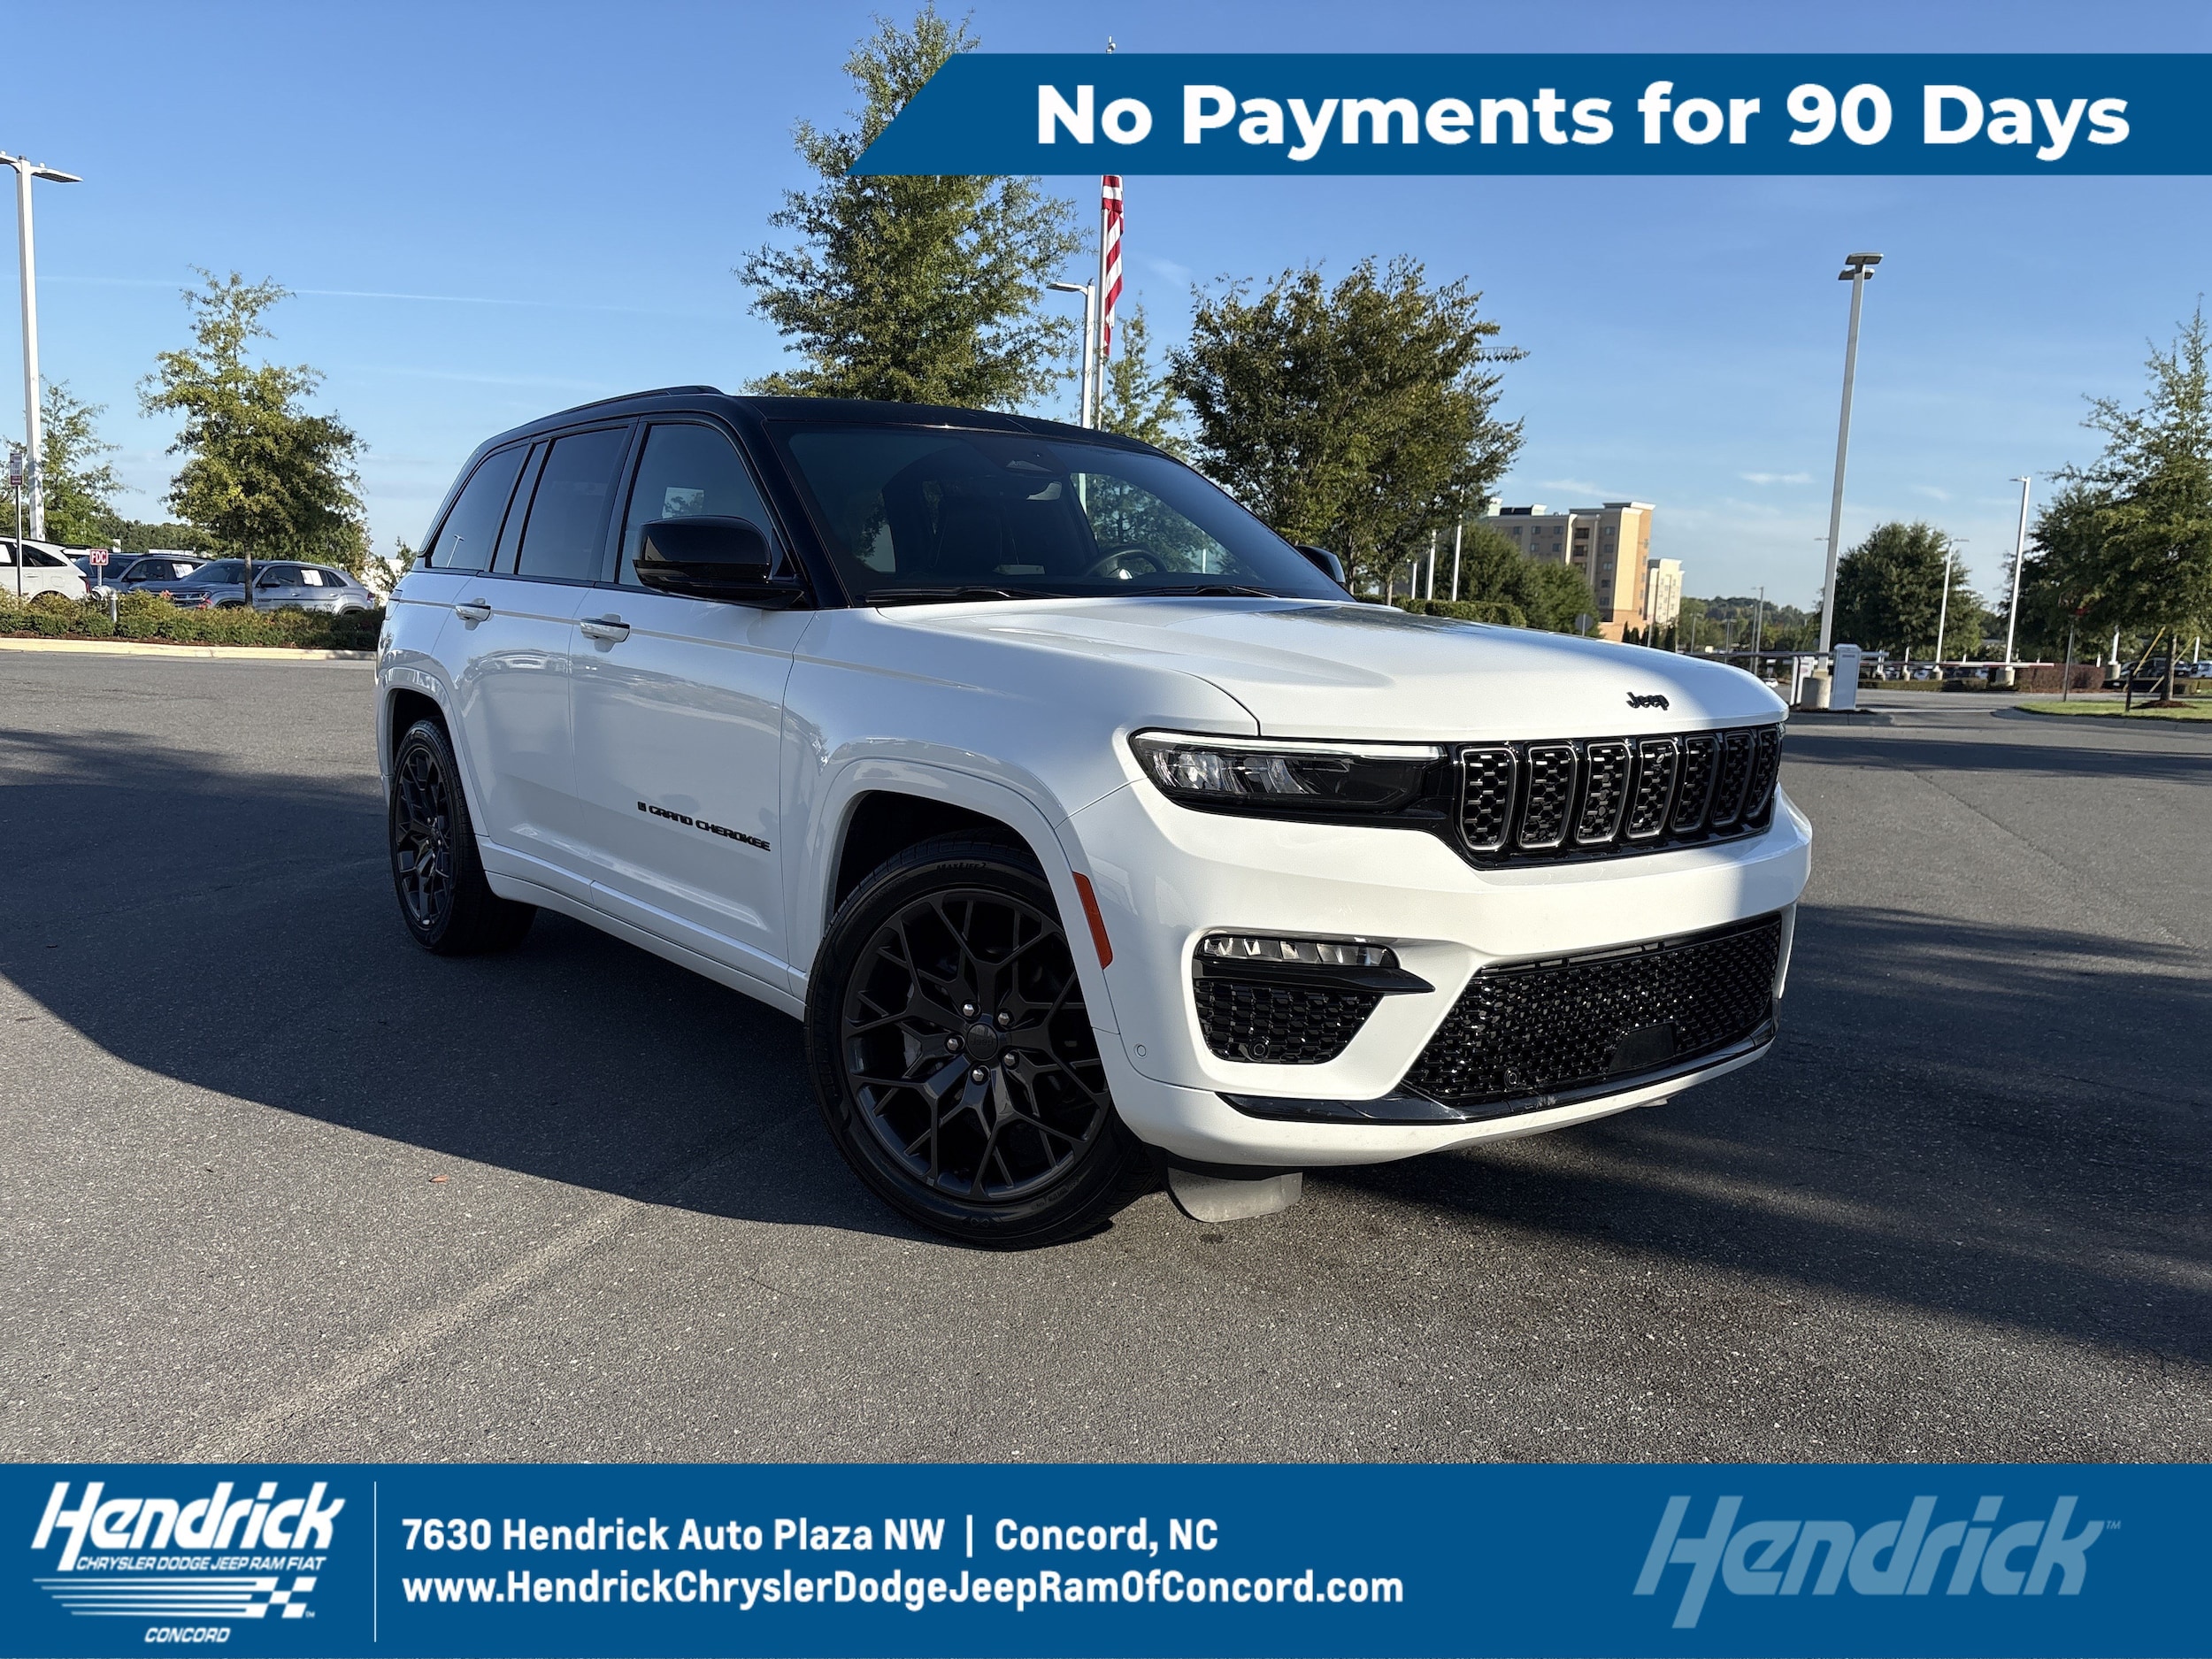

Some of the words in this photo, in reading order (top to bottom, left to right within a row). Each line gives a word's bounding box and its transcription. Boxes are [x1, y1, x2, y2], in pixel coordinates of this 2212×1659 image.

[91, 550, 106, 564] FDC
[1626, 691, 1670, 710] Jeep
[649, 805, 693, 826] GRAND
[695, 819, 772, 852] CHEROKEE
